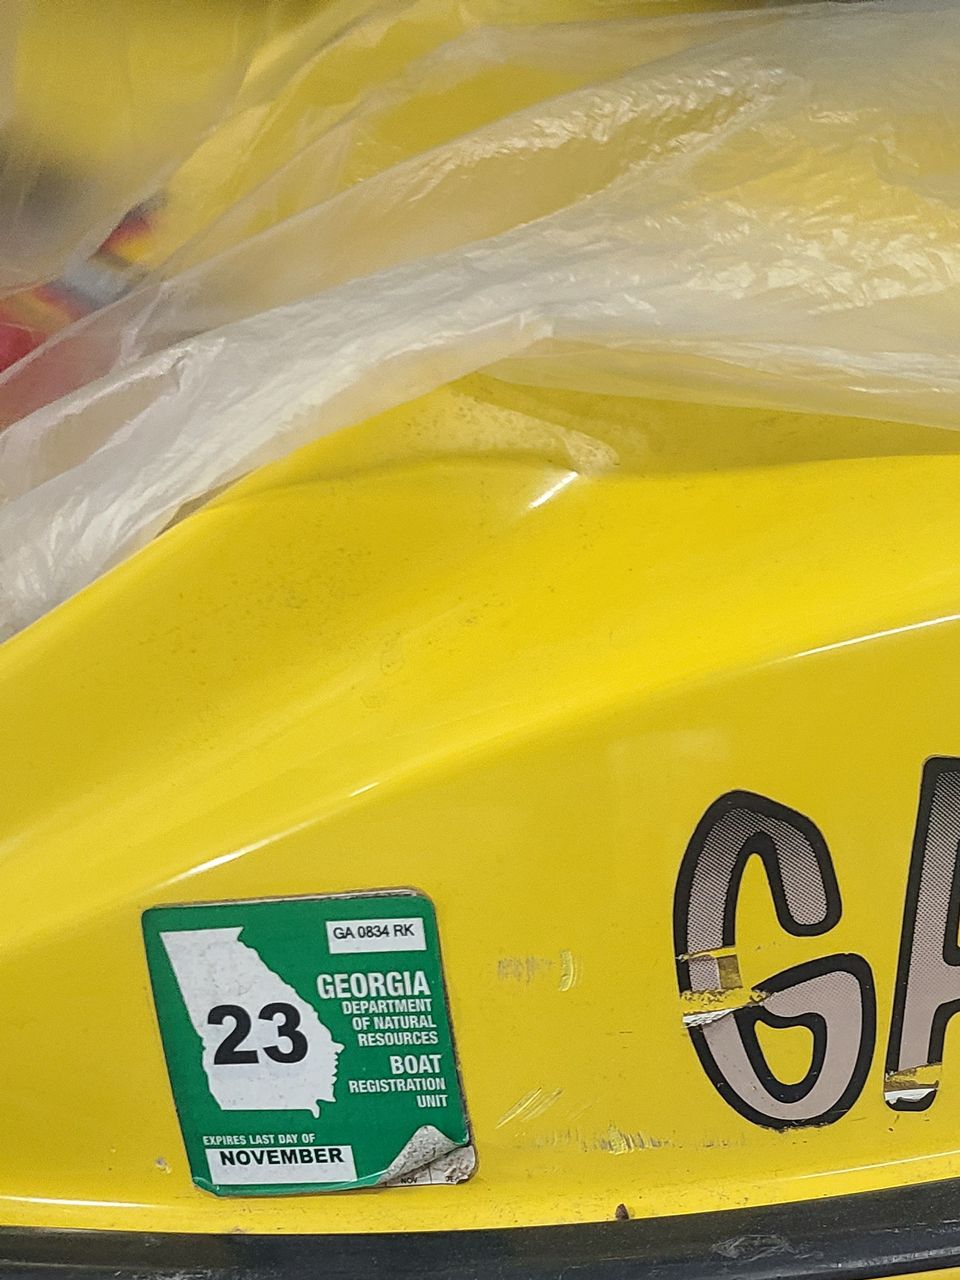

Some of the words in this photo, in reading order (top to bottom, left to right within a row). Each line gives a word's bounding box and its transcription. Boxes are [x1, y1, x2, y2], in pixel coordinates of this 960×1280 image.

[333, 926, 356, 940] GA
[357, 924, 391, 939] 0834
[393, 923, 415, 937] RK
[316, 970, 432, 999] GEORGIA
[341, 998, 433, 1015] DEPARTMENT
[352, 1016, 372, 1031] OF
[373, 1014, 437, 1030] NATURAL
[206, 1002, 309, 1065] 23
[357, 1030, 439, 1047] RESOURCES
[389, 1054, 442, 1075] BOAT
[348, 1077, 446, 1093] REGISTRATION
[416, 1094, 448, 1108] UNIT
[202, 1135, 247, 1146] EXPIRES
[249, 1134, 275, 1145] LAST
[278, 1133, 299, 1144] DAY
[301, 1133, 316, 1144] OF
[219, 1147, 345, 1166] NOVEMBER
